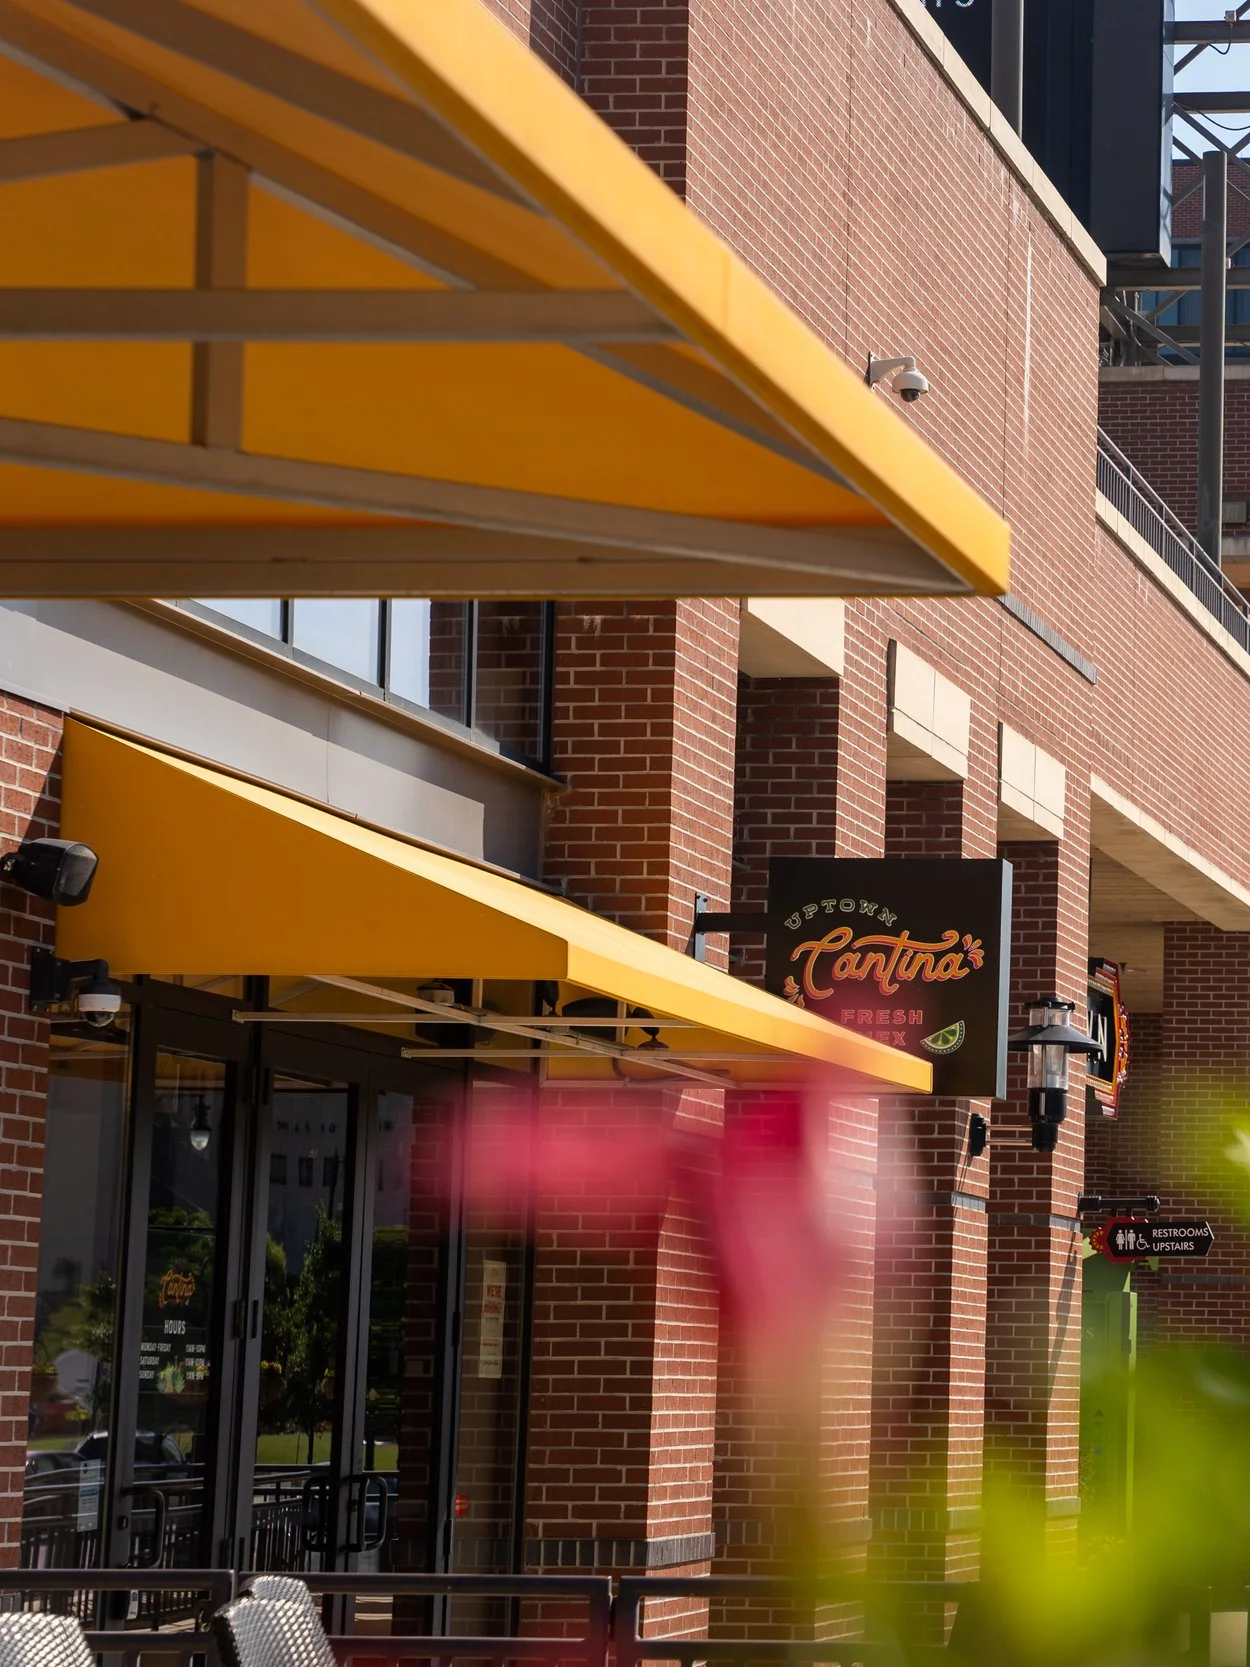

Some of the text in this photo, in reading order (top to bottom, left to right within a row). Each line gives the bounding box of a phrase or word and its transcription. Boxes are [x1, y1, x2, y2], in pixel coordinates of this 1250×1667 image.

[784, 898, 898, 930] UPTOWN
[790, 926, 970, 1000] Cantina
[840, 1009, 923, 1025] FRESH
[1152, 1227, 1209, 1238] RESTROOMS
[1152, 1241, 1195, 1252] UPSTAIRS
[164, 1319, 186, 1335] HOURS
[140, 1356, 160, 1365] SATURDAY
[139, 1370, 155, 1379] SUNDAY
